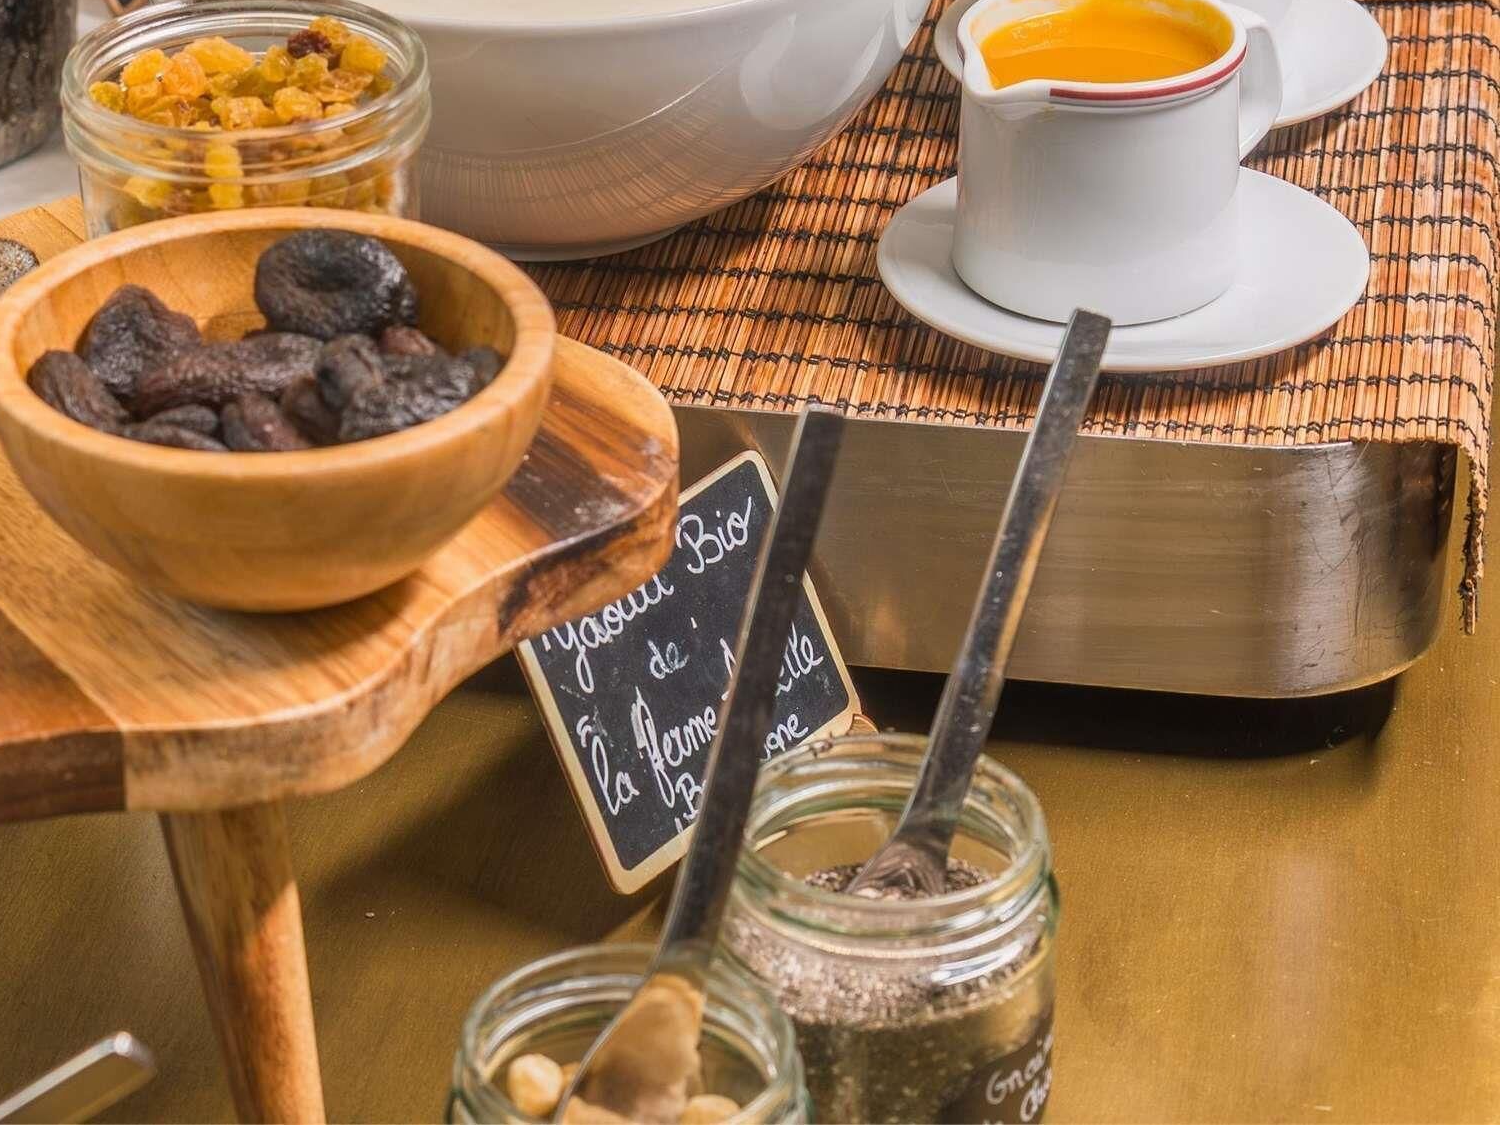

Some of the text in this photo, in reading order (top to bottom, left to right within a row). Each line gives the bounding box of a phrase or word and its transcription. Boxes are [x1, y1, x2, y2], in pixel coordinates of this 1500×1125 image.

[675, 495, 752, 575] Bio
[647, 638, 690, 681] de
[590, 685, 719, 817] la ferme
